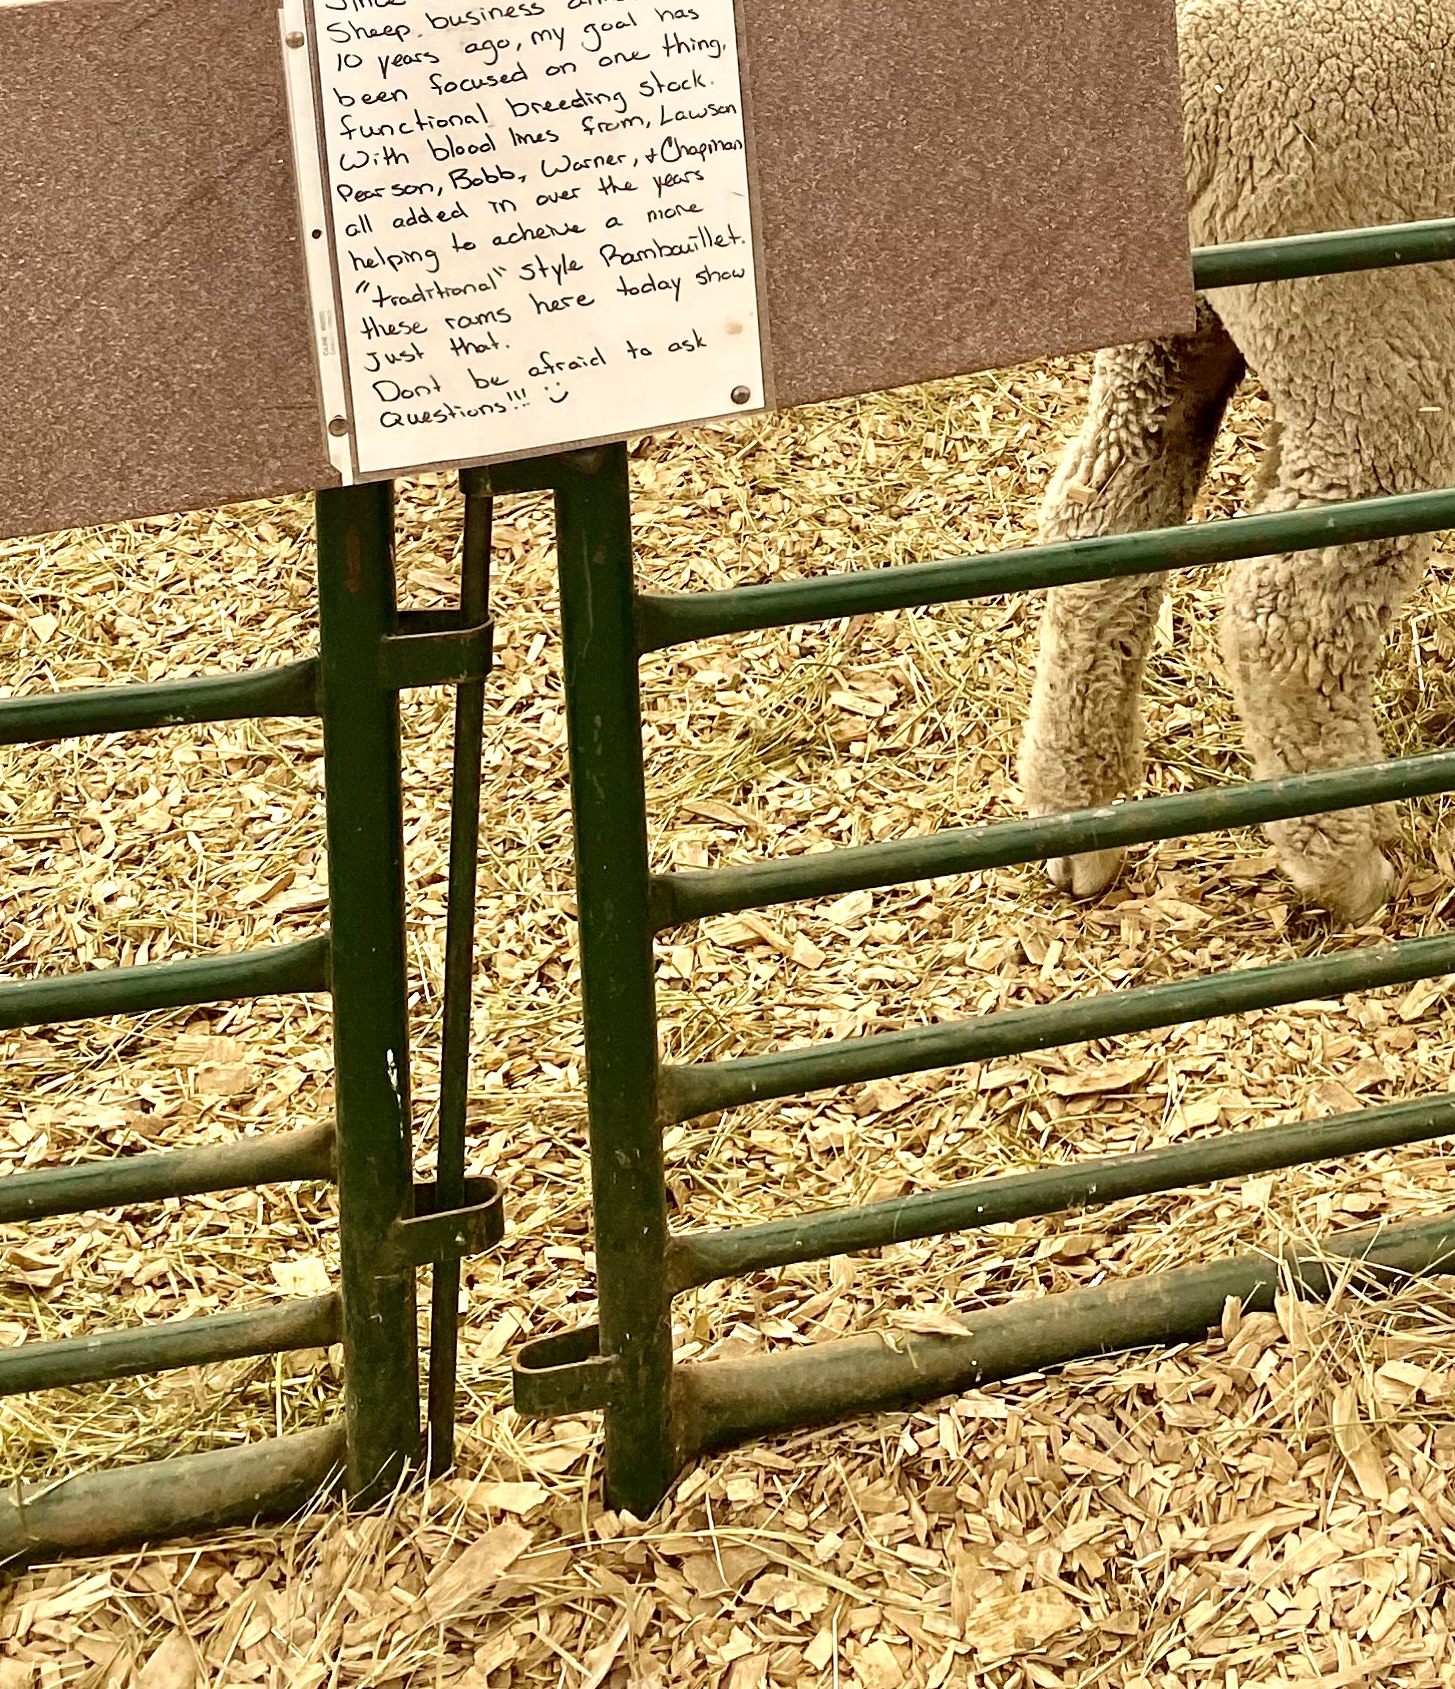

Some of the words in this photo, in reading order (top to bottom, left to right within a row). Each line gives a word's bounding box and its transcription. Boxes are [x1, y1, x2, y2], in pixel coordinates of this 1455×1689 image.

[336, 53, 364, 72] 10
[377, 52, 441, 80] years
[464, 38, 522, 66] ago,
[530, 27, 565, 51] my
[580, 11, 638, 52] goal
[654, 8, 700, 22] has
[424, 2, 546, 30] business
[332, 87, 409, 107] been
[429, 61, 529, 96] focused
[545, 61, 577, 77] on
[598, 51, 651, 68] one
[339, 102, 490, 141] functional
[505, 88, 628, 118] breeding
[339, 145, 410, 172] With
[426, 132, 497, 162] blood
[508, 126, 560, 147] lines
[581, 115, 652, 136] from,
[659, 102, 739, 126] Lawson
[336, 183, 444, 203] Pearson,
[447, 163, 528, 190] Bobb,
[540, 153, 640, 178] Warner,
[345, 213, 374, 237] all
[392, 200, 470, 229] added
[487, 198, 518, 214] in
[535, 187, 582, 206] over
[597, 175, 639, 196] the
[652, 169, 705, 198] years
[348, 246, 440, 274] helping
[451, 231, 477, 253] to
[604, 216, 625, 229] a
[646, 203, 705, 223] more
[359, 315, 429, 341] these
[444, 307, 513, 331] rams
[528, 292, 596, 316] here
[616, 272, 682, 303] today
[695, 264, 746, 285] show
[372, 373, 443, 403] Dont
[467, 367, 511, 390] be
[528, 345, 608, 378] afraid
[625, 339, 653, 360] to
[667, 327, 708, 354] ask
[449, 330, 511, 358] that.
[379, 386, 531, 429] Questions!!!
